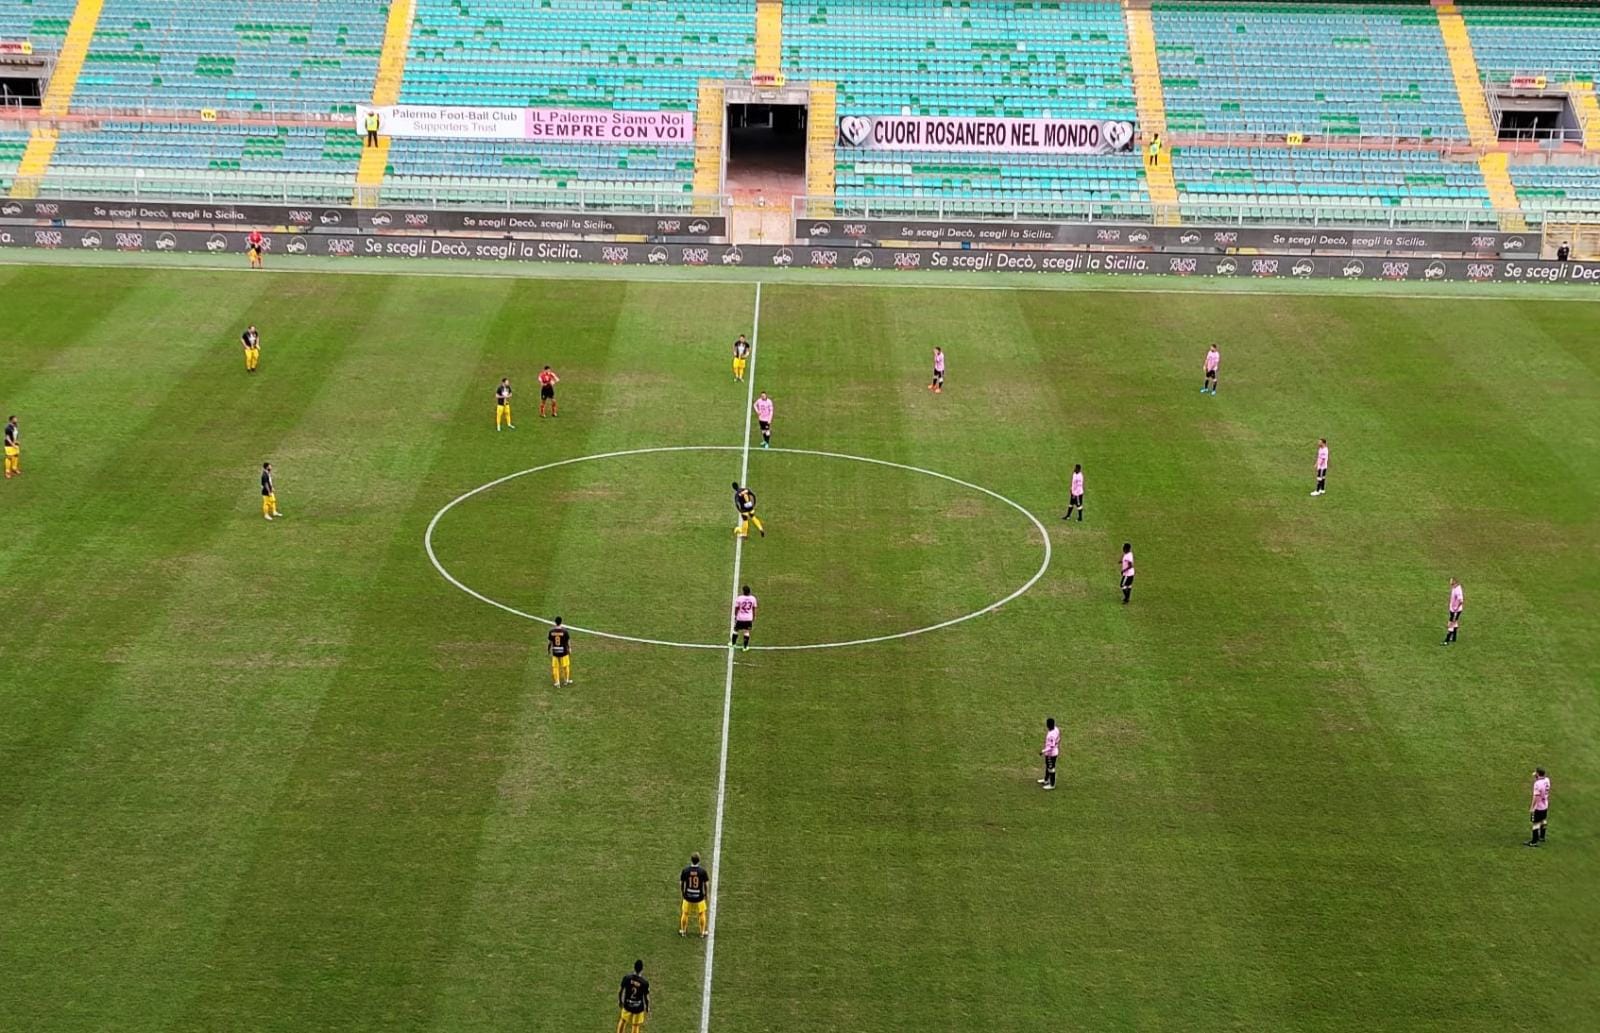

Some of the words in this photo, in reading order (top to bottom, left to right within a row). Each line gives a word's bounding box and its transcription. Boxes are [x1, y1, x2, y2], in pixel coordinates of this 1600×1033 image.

[392, 109, 437, 120] Palermo
[440, 110, 489, 120] Foot-Ball
[492, 111, 518, 121] Club
[550, 112, 608, 124] Palermo
[612, 113, 656, 125] Siamo
[661, 114, 684, 125] Noi
[413, 121, 469, 133] Supporters
[472, 122, 497, 132] Trust
[533, 124, 605, 137] SEMPRE
[611, 125, 648, 138] CON
[655, 126, 684, 138] VOI
[874, 120, 920, 144] CUORI
[925, 121, 1006, 146] ROSANERO
[1011, 122, 1039, 147] NEL
[1043, 123, 1099, 147] MONDO
[365, 239, 382, 252] Se
[386, 240, 426, 256] scegli
[475, 242, 516, 259] scegli
[520, 242, 533, 257] la
[537, 244, 582, 259] Sicilia.
[930, 251, 948, 266] Se
[952, 252, 993, 270] scegli
[1042, 254, 1083, 271] scegli
[1087, 254, 1099, 269] la
[1104, 255, 1149, 270] Sicilia.
[1504, 263, 1522, 277] Se
[1526, 263, 1568, 280] scegli
[741, 601, 753, 611] 23
[689, 876, 699, 889] 19
[630, 987, 638, 999] 2
